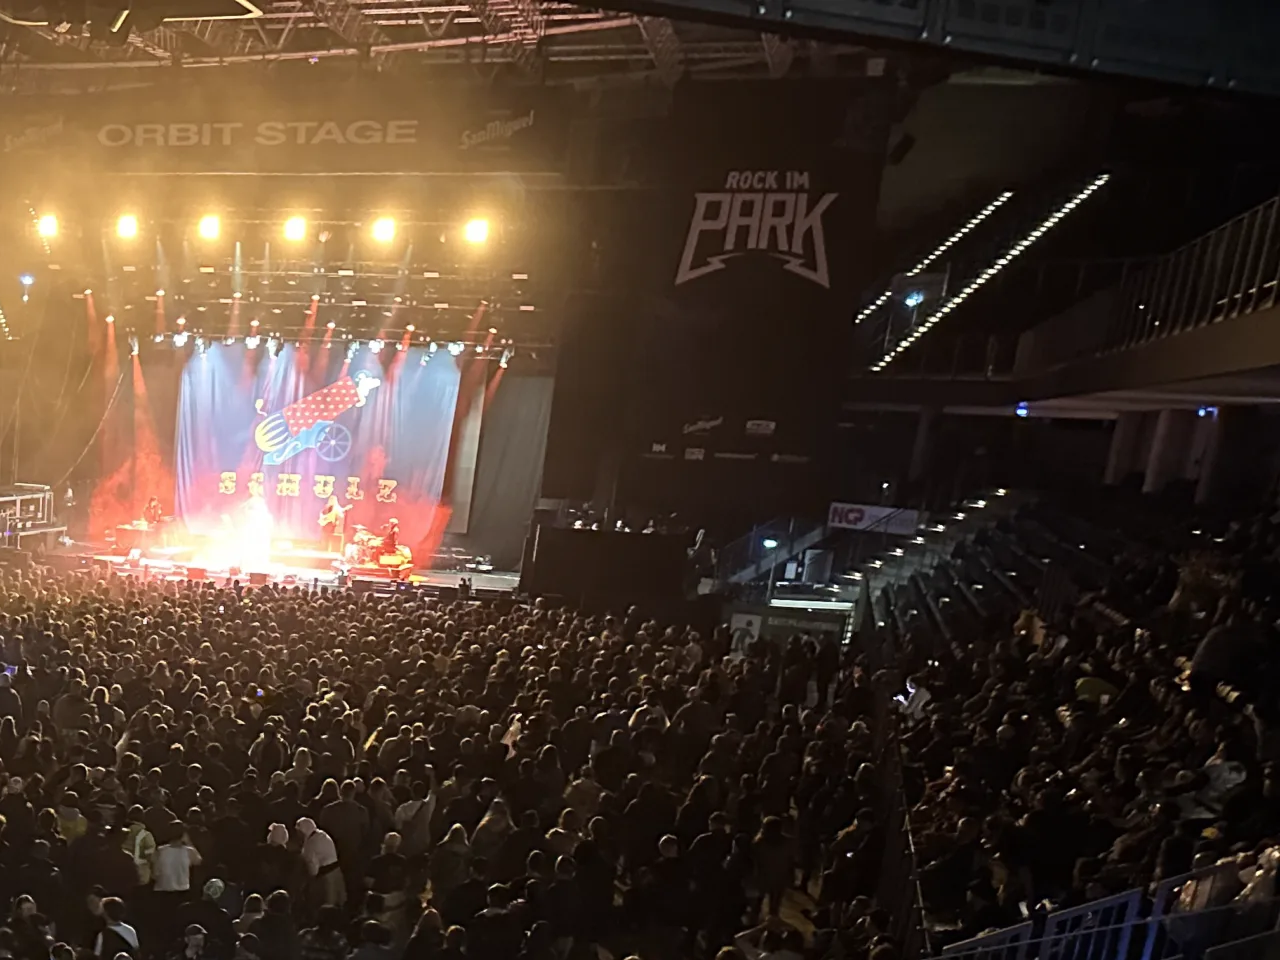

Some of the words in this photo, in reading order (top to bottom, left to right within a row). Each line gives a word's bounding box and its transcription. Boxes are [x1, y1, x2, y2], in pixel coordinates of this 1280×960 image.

[97, 123, 243, 146] ORBIT
[254, 120, 419, 146] STAGE
[724, 170, 779, 189] ROCK
[785, 170, 811, 189] IM
[674, 192, 840, 289] PARK
